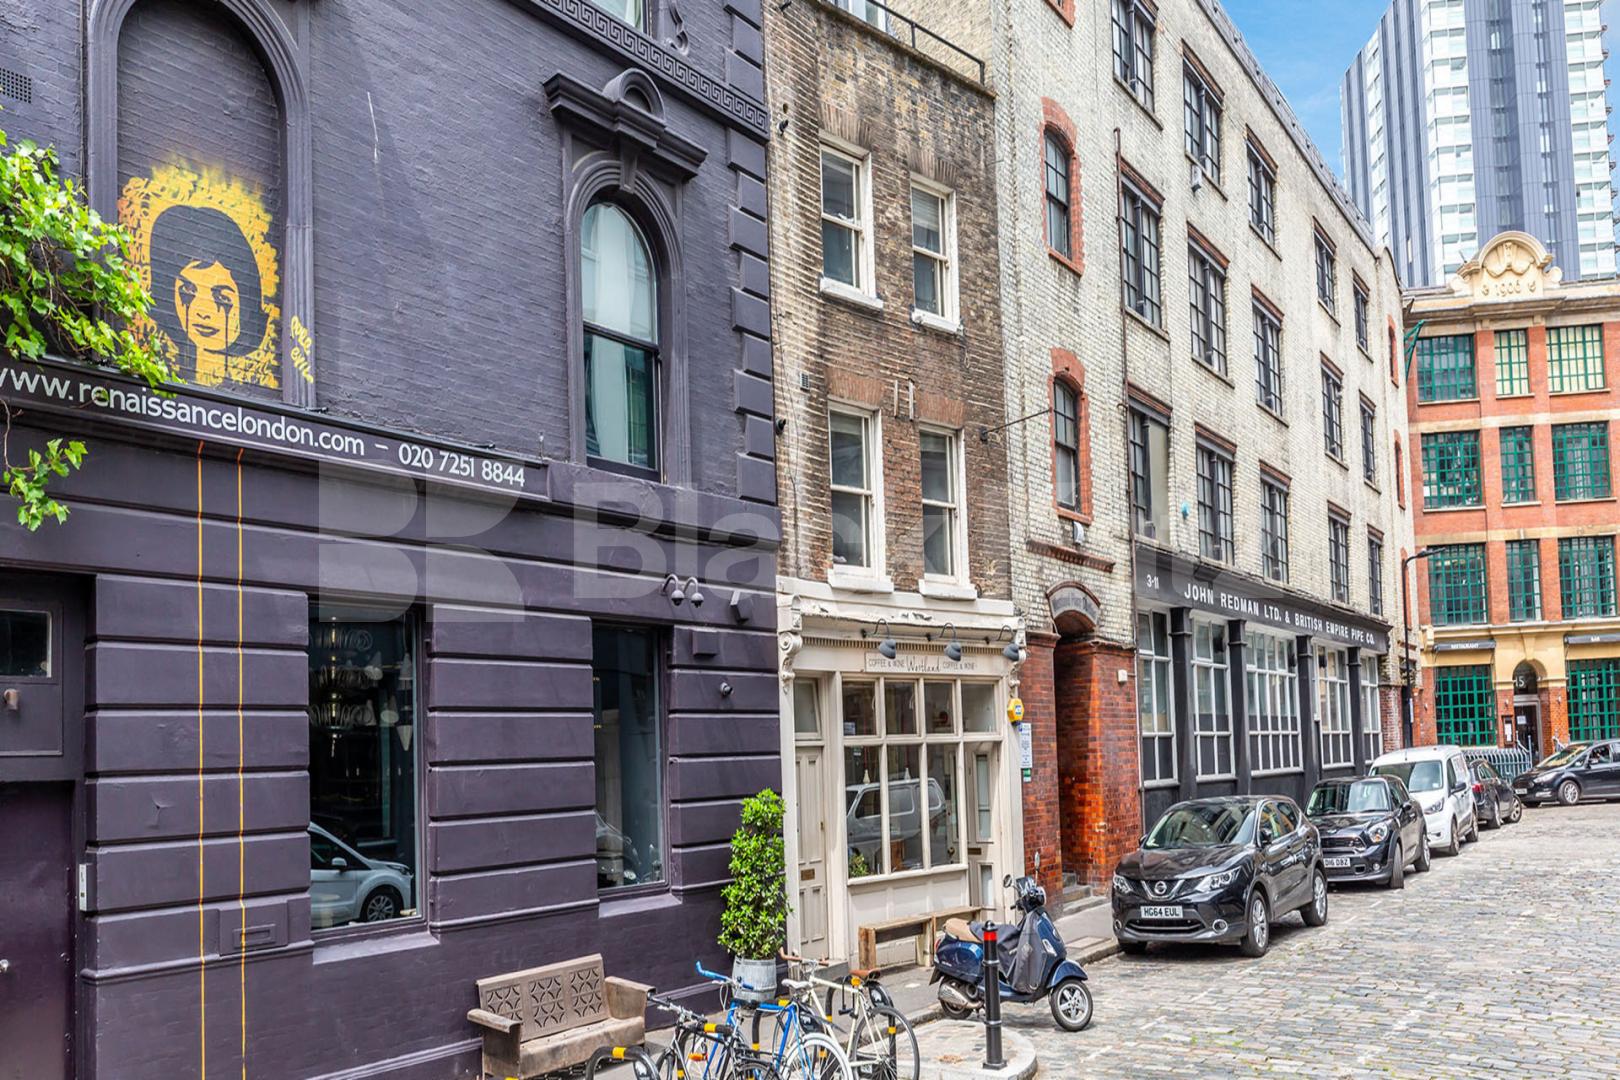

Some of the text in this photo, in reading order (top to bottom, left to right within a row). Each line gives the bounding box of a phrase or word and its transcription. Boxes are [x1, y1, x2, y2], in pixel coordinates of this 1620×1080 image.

[0, 367, 365, 456] ww.renaissancelondon.com
[398, 443, 434, 469] 020
[439, 451, 475, 478] 7251
[481, 460, 525, 487] 8844
[1184, 583, 1214, 605] JOHN
[1220, 592, 1260, 616] REDMAN
[1264, 604, 1282, 621] LTD.
[1285, 610, 1291, 624] &
[1294, 612, 1323, 632] BRITISH
[1326, 620, 1349, 639] EMPIRE
[1351, 627, 1364, 642] PIPE
[868, 658, 887, 668] COFFEE
[1143, 907, 1180, 917] HG64 EUL
